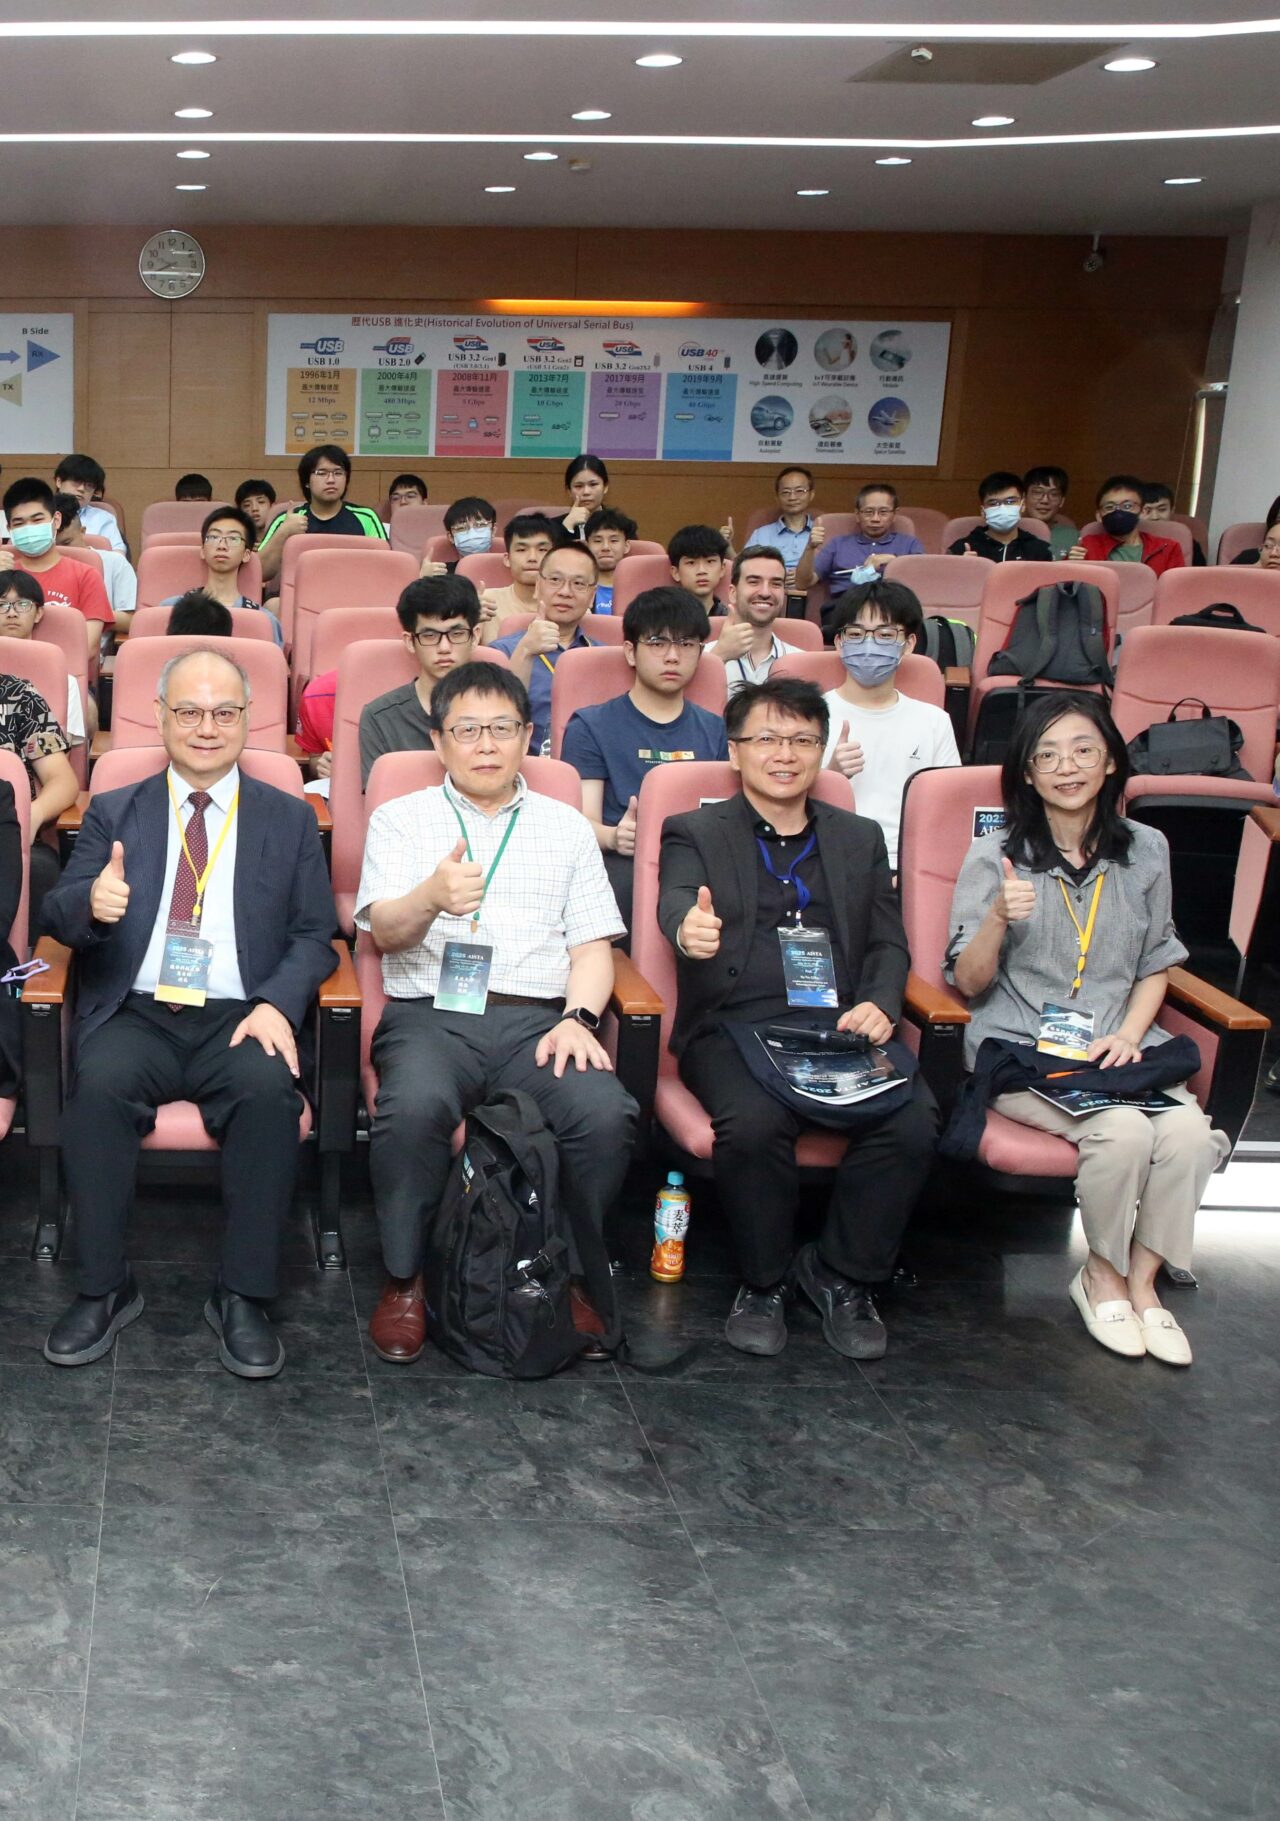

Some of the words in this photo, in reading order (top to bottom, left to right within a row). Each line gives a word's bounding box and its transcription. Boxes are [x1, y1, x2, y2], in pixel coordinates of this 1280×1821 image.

[475, 319, 521, 328] Evolution
[524, 319, 534, 328] of
[536, 319, 581, 329] Universal
[584, 320, 610, 330] Serial
[612, 320, 634, 331] Bus)
[30, 327, 49, 335] Side
[317, 340, 344, 352] USB
[464, 340, 482, 348] USB
[388, 343, 414, 354] USB
[615, 345, 634, 353] USB
[681, 348, 705, 357] USB
[307, 357, 326, 365] USB
[328, 357, 340, 365] 1.0
[448, 353, 466, 361] USB
[523, 355, 541, 363] USB
[378, 358, 397, 366] USB
[399, 358, 411, 366] 2.0
[595, 362, 613, 370] USB
[300, 370, 340, 380] 1996年1月
[377, 371, 418, 381] 2000年4月
[452, 373, 497, 382] 2008年11月
